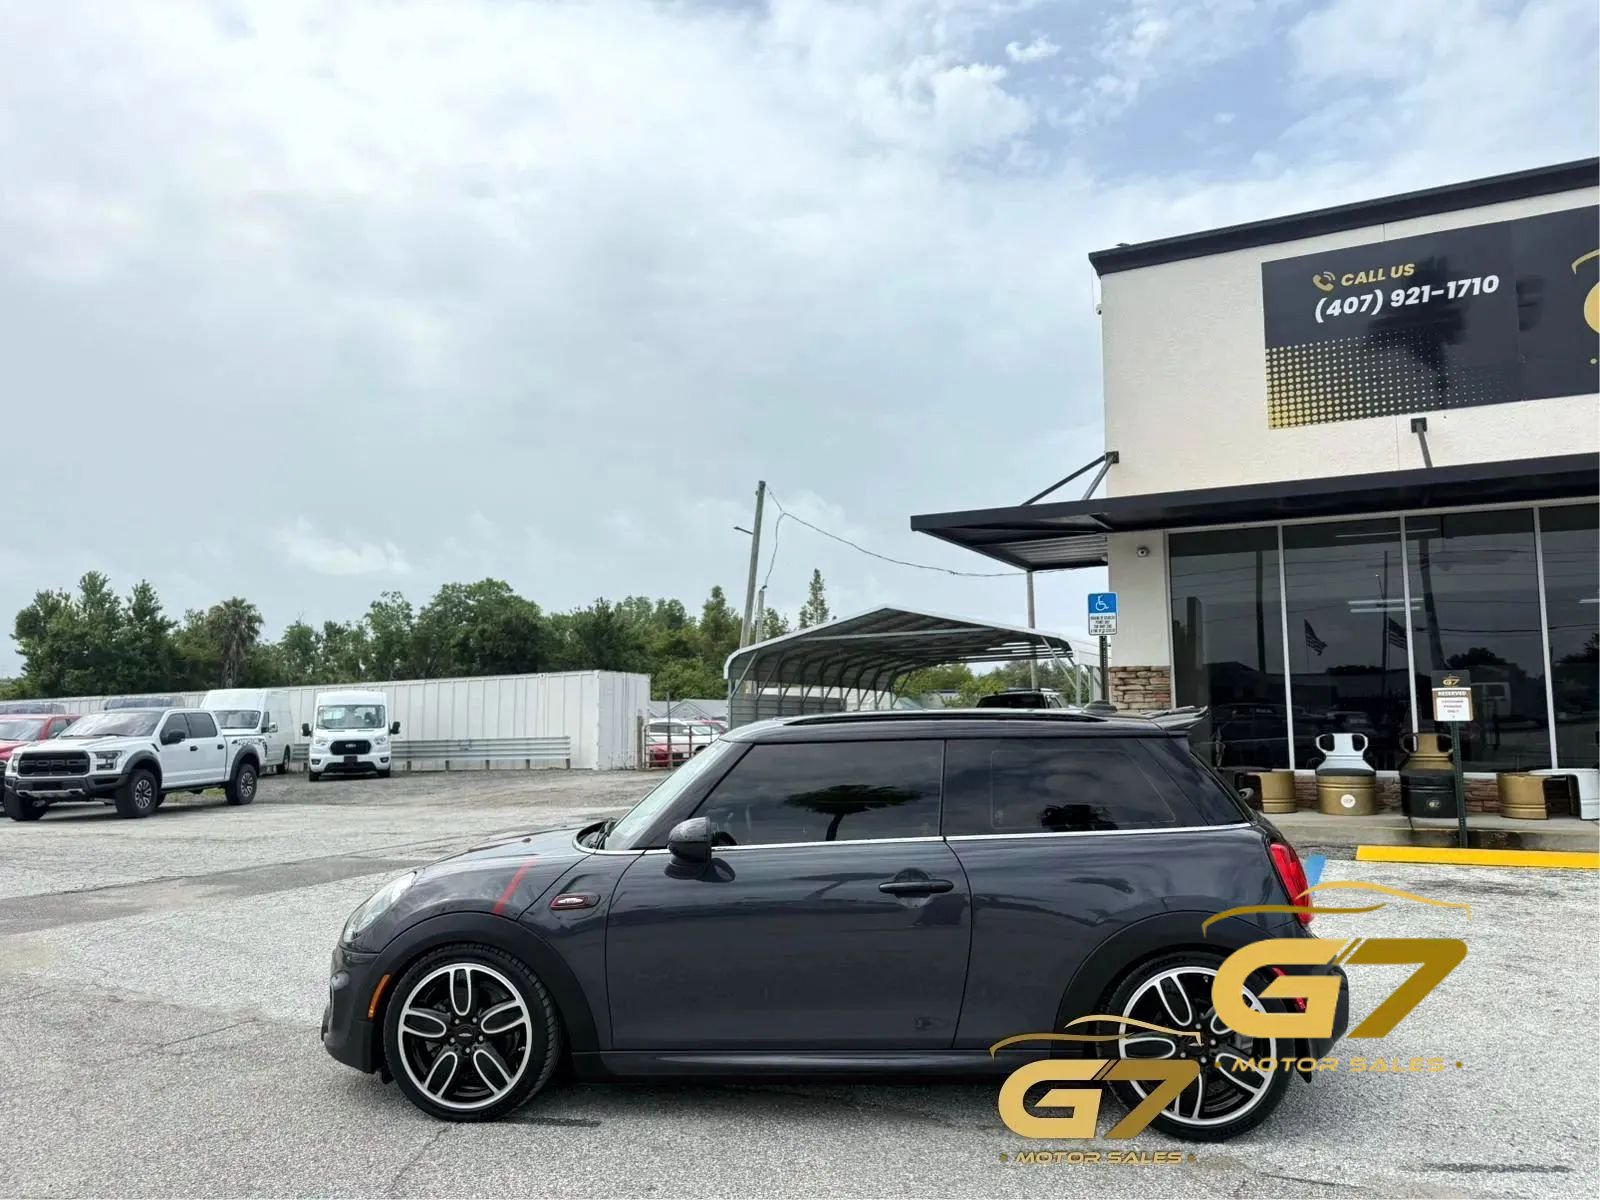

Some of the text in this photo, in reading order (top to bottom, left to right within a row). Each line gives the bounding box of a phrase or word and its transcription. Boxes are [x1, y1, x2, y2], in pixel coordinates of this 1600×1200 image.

[1340, 263, 1415, 287] CALL US
[1314, 274, 1500, 324] (407) 921-1710
